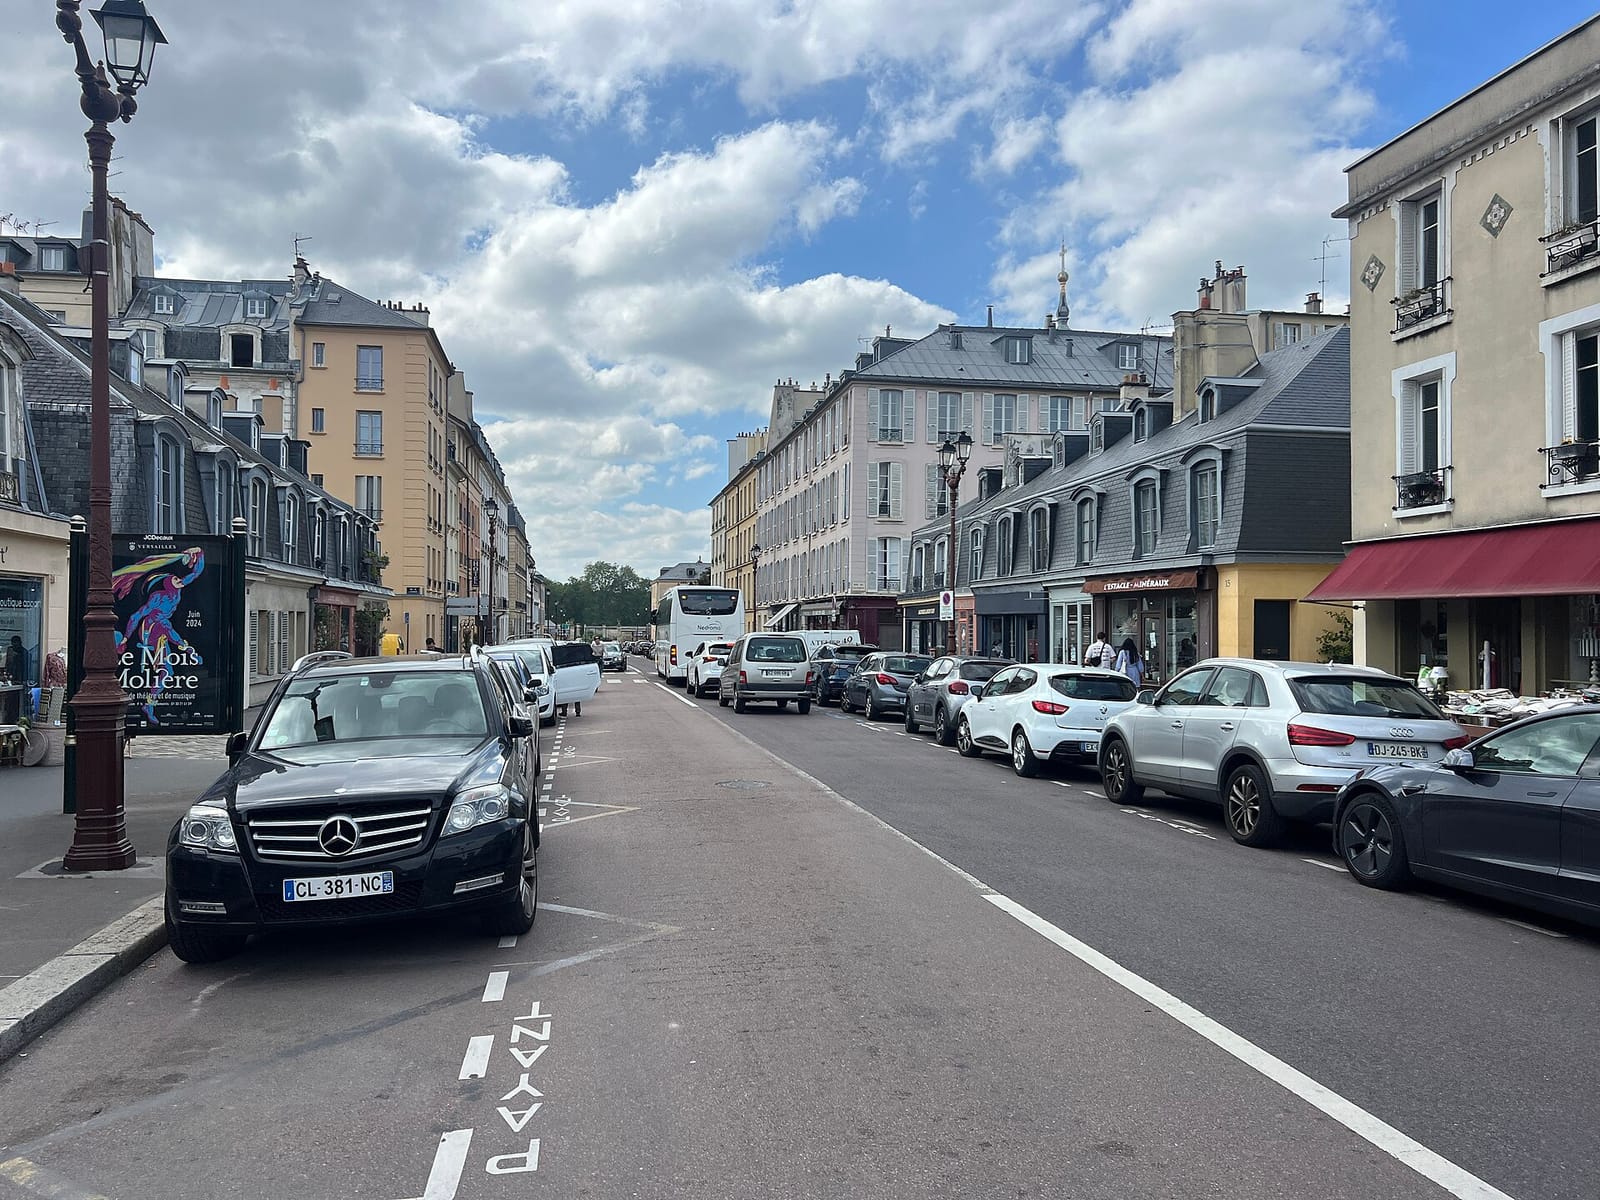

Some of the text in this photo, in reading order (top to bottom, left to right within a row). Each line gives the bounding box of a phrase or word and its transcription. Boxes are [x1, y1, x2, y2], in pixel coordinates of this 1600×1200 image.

[1103, 582, 1130, 591] L'ESTACLE
[1133, 579, 1169, 588] MINÉRAUX
[188, 610, 200, 618] Juin
[186, 619, 202, 627] 2024
[118, 646, 199, 666] e Mois
[164, 692, 172, 700] de
[172, 692, 196, 701] musique
[485, 1001, 552, 1175] PAYANT
